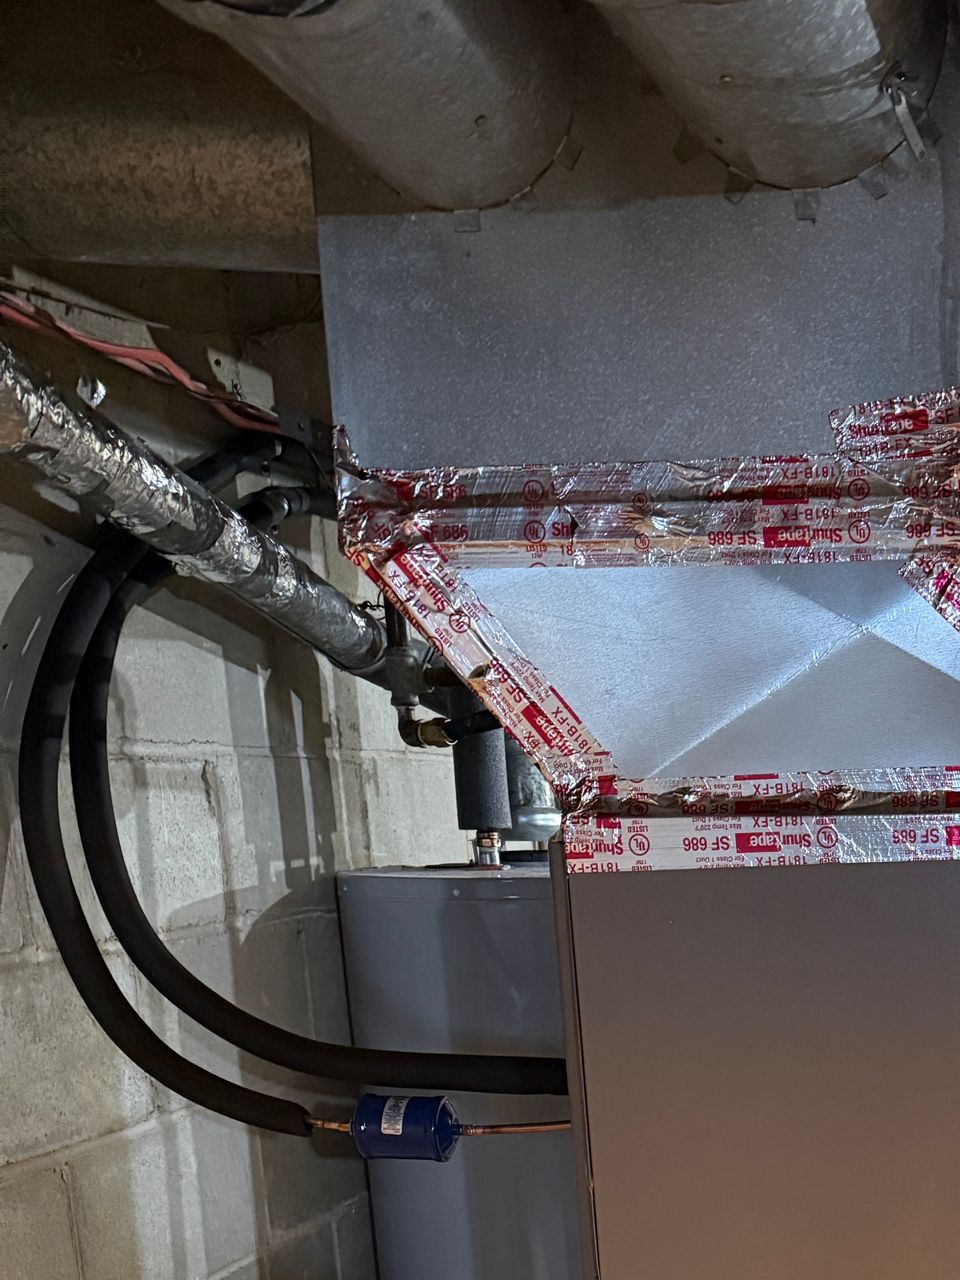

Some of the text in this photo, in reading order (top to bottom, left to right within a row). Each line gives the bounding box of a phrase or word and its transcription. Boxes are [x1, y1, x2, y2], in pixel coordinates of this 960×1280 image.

[781, 466, 835, 479] 181B-FX
[782, 508, 836, 521] 181B-FX
[737, 530, 756, 545] SF
[777, 527, 843, 544] Shurtape
[905, 521, 955, 539] SF 686
[708, 530, 734, 546] 686
[399, 553, 448, 610] Shurtape
[551, 707, 592, 753] 181B-FX
[753, 782, 804, 795] 181B-FX
[627, 825, 649, 833] LISTED
[712, 822, 728, 830] Temp
[752, 816, 804, 828] 181B-FX
[682, 836, 708, 851] 686
[711, 836, 730, 851] SF
[749, 831, 812, 848] Shurtape
[892, 829, 940, 845] SF 686
[564, 840, 624, 856] Shurtape
[568, 861, 621, 873] 181B-FX
